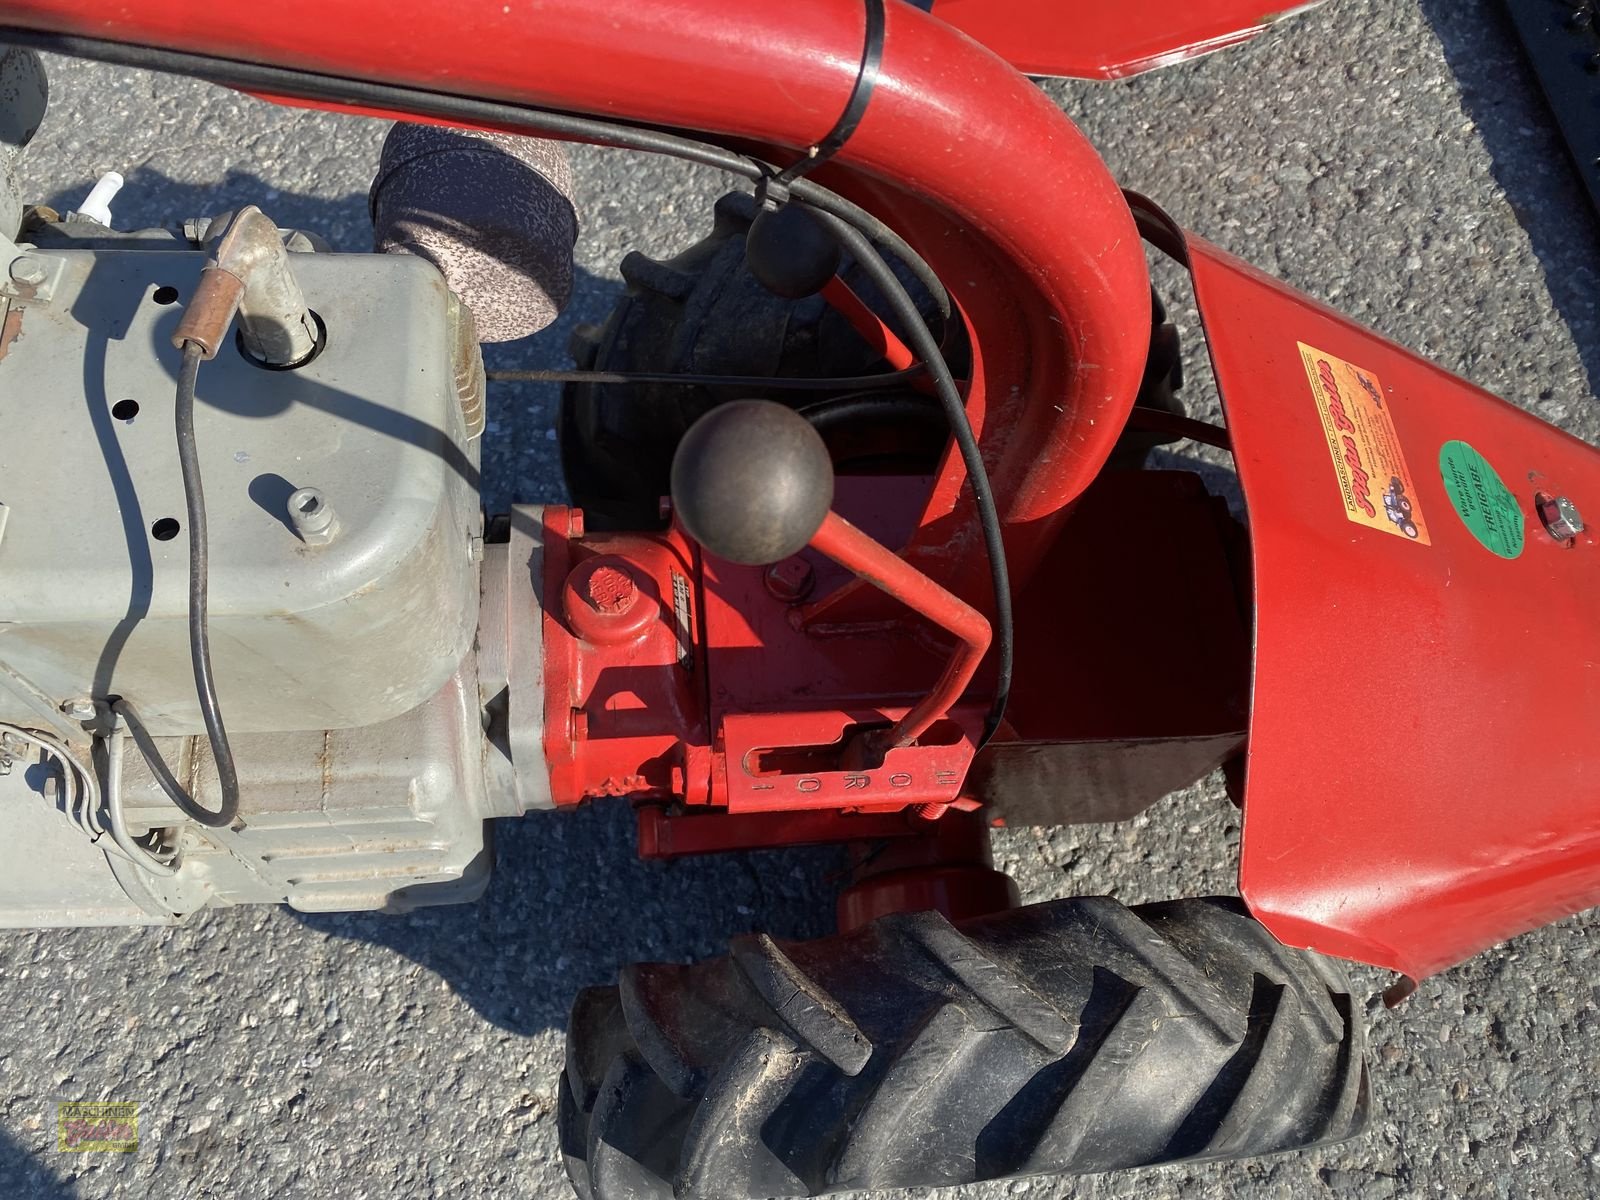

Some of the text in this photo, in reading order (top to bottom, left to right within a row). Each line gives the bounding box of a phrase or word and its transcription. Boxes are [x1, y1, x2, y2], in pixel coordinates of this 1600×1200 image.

[1317, 358, 1356, 435] Gailer
[1330, 438, 1355, 512] LANDMASCHINEN
[1343, 435, 1376, 518] Stefan
[1447, 457, 1470, 518] Ware wurde
[1468, 463, 1497, 533] FREIGABE
[844, 774, 870, 789] R
